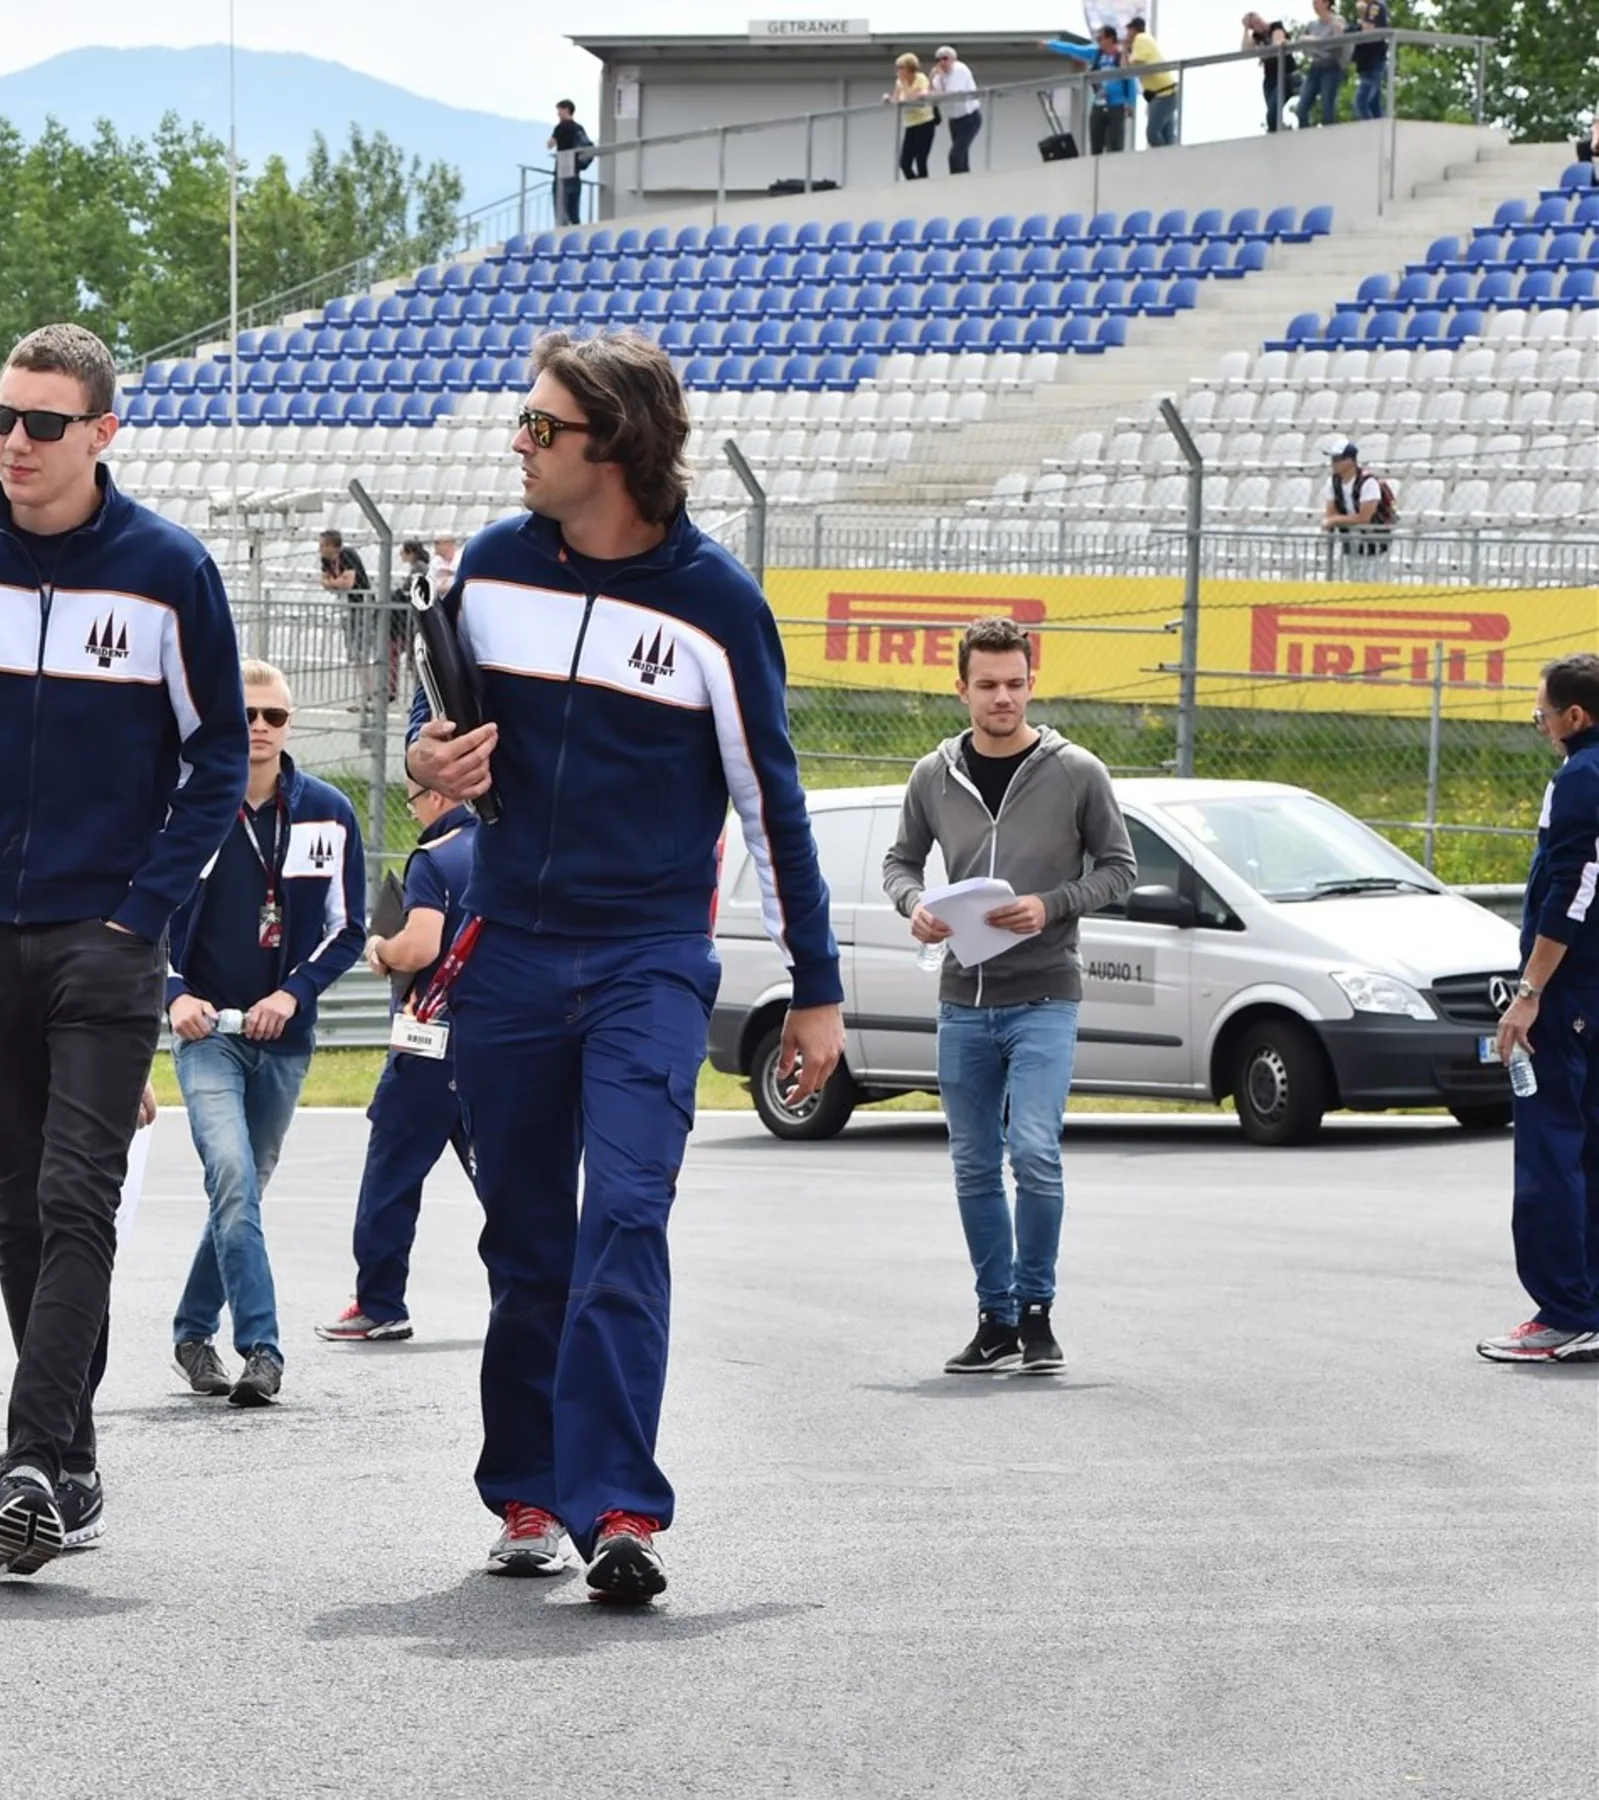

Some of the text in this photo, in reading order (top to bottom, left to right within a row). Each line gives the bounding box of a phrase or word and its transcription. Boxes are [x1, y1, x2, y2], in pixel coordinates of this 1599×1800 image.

[825, 592, 1047, 670] PIREI
[84, 645, 129, 659] TRIDENT
[1250, 604, 1511, 690] PIRELLI
[627, 659, 675, 677] TRIDENT
[1087, 961, 1143, 983] AUDIO 1
